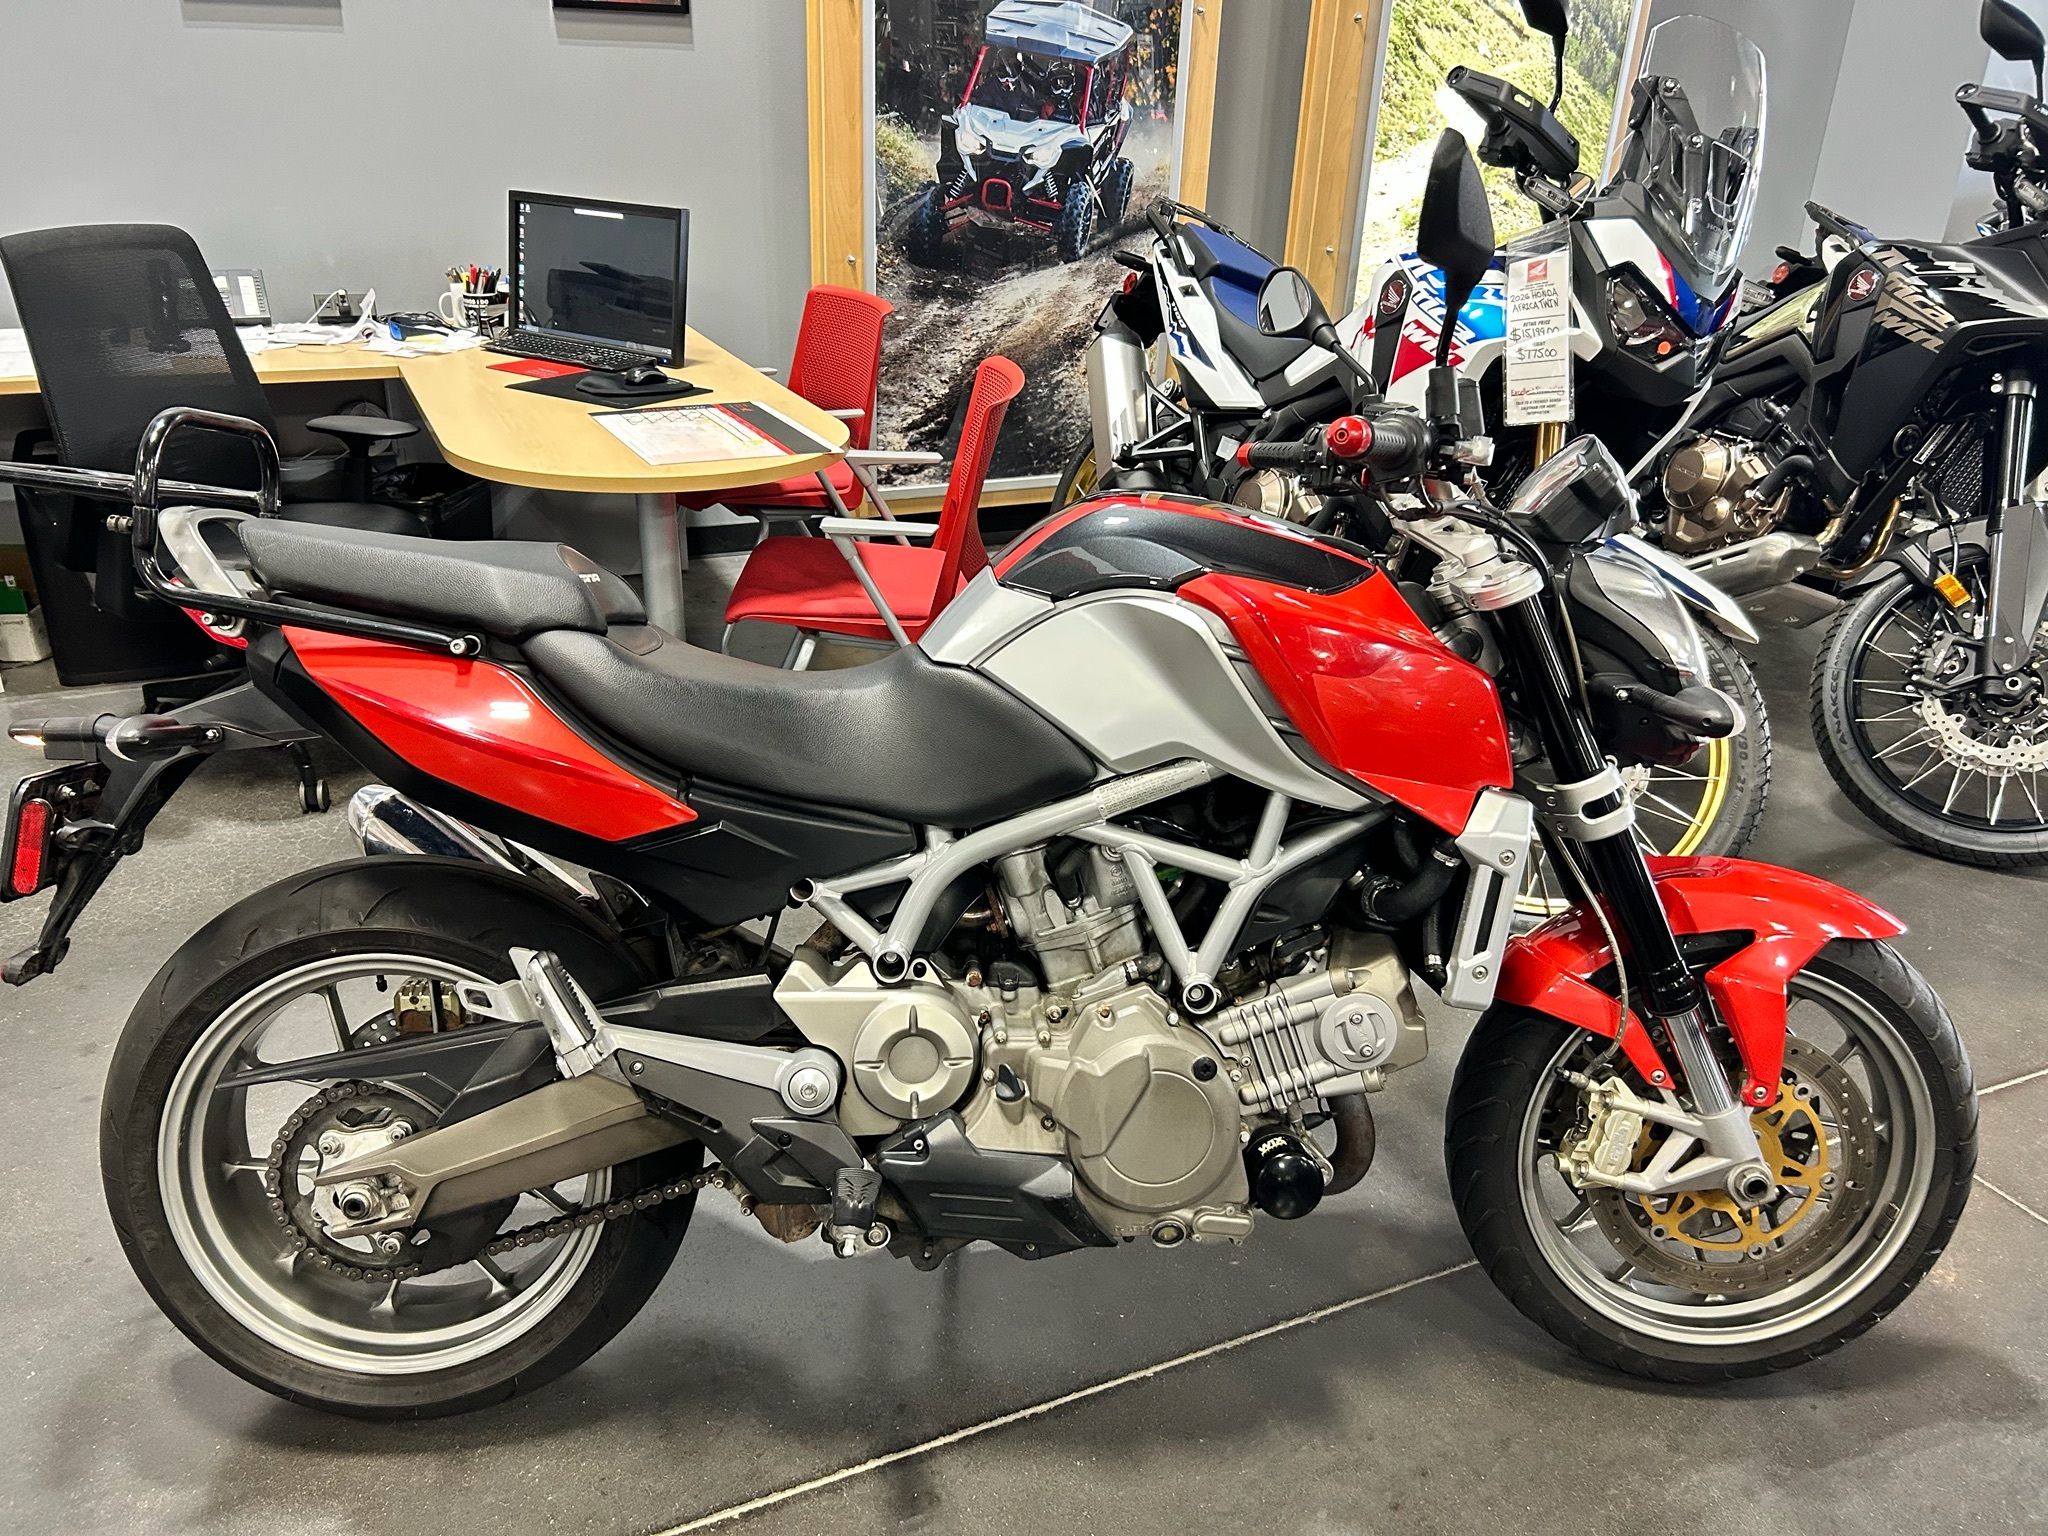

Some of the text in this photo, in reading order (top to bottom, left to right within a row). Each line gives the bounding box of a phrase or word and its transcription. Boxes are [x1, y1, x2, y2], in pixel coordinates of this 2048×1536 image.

[1510, 287, 1559, 303] 2026 HONDA
[1869, 246, 1957, 330] Africa
[1171, 300, 1187, 329] 1100
[1512, 297, 1559, 313] AFRICA TWIN
[1872, 291, 1944, 354] Twin
[1516, 347, 1558, 361] $775.00
[1833, 611, 1863, 667] ADVENTURE
[1829, 670, 1848, 746] ANAKEE
[1258, 1136, 1288, 1157] WIX
